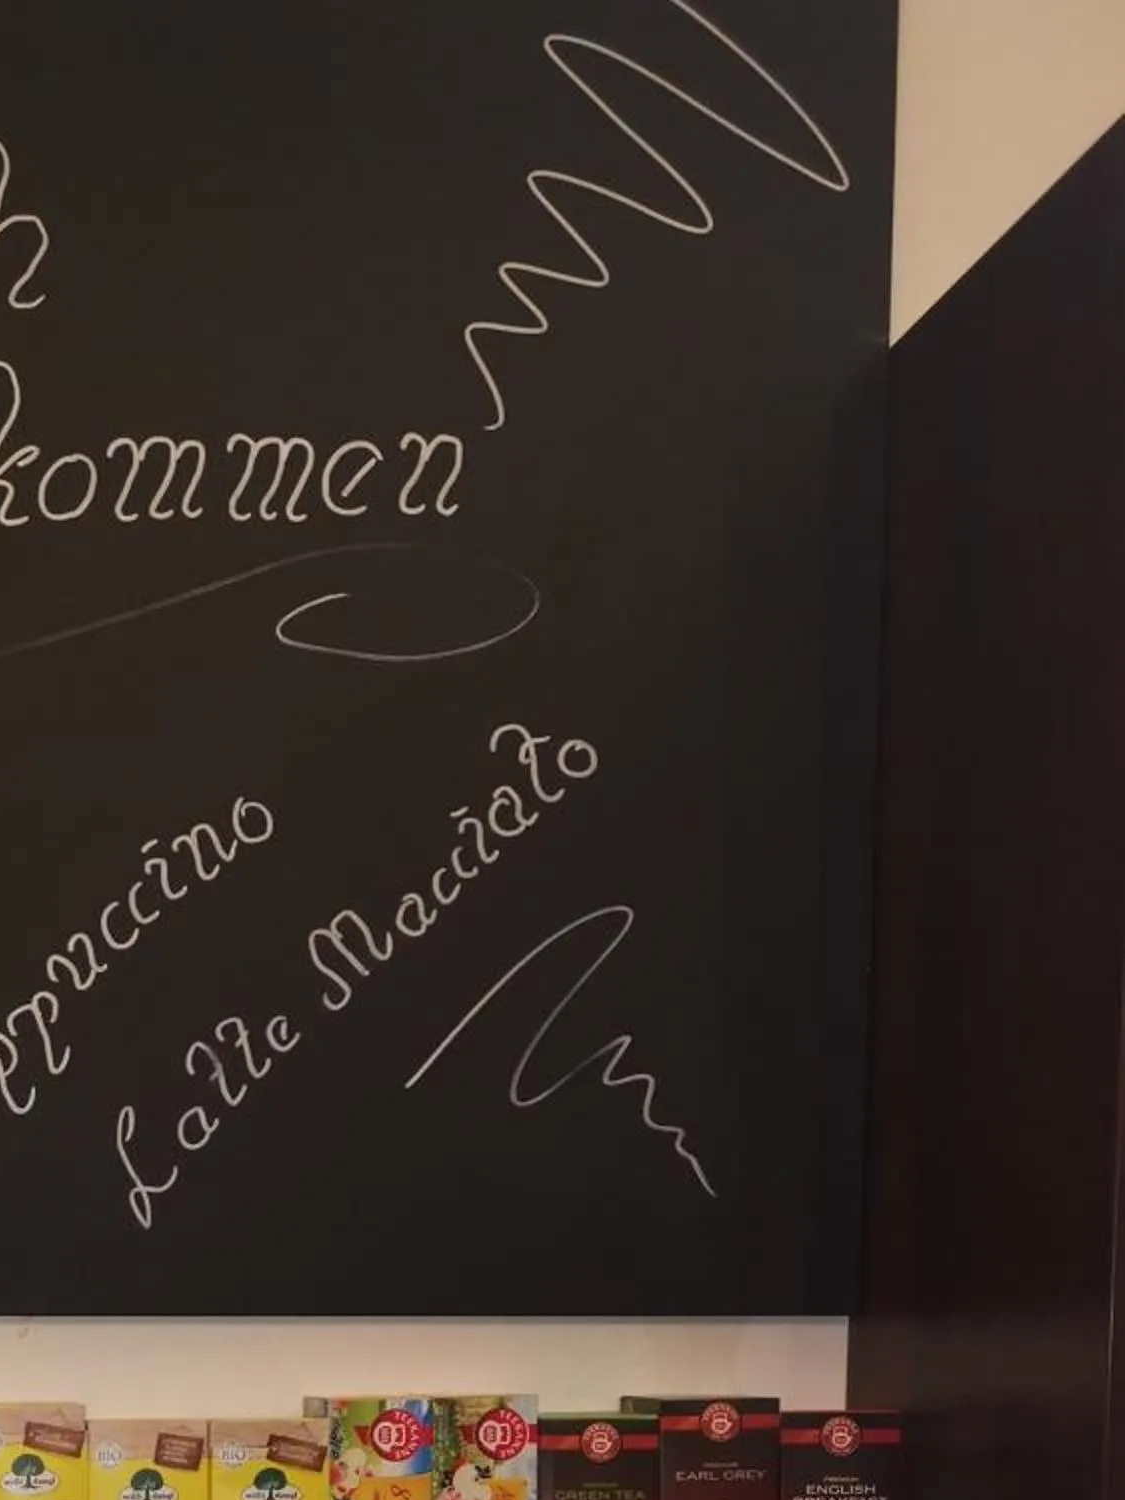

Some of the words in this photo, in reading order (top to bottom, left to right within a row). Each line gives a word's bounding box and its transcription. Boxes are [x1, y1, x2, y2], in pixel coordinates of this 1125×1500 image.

[115, 1014, 302, 1230] Latte
[308, 722, 600, 1011] Macciato
[675, 1470, 718, 1482] EARL
[723, 1469, 768, 1481] GREY
[555, 1490, 610, 1500] GREEN
[613, 1489, 647, 1500] TEA
[805, 1484, 876, 1495] ENGLISH
